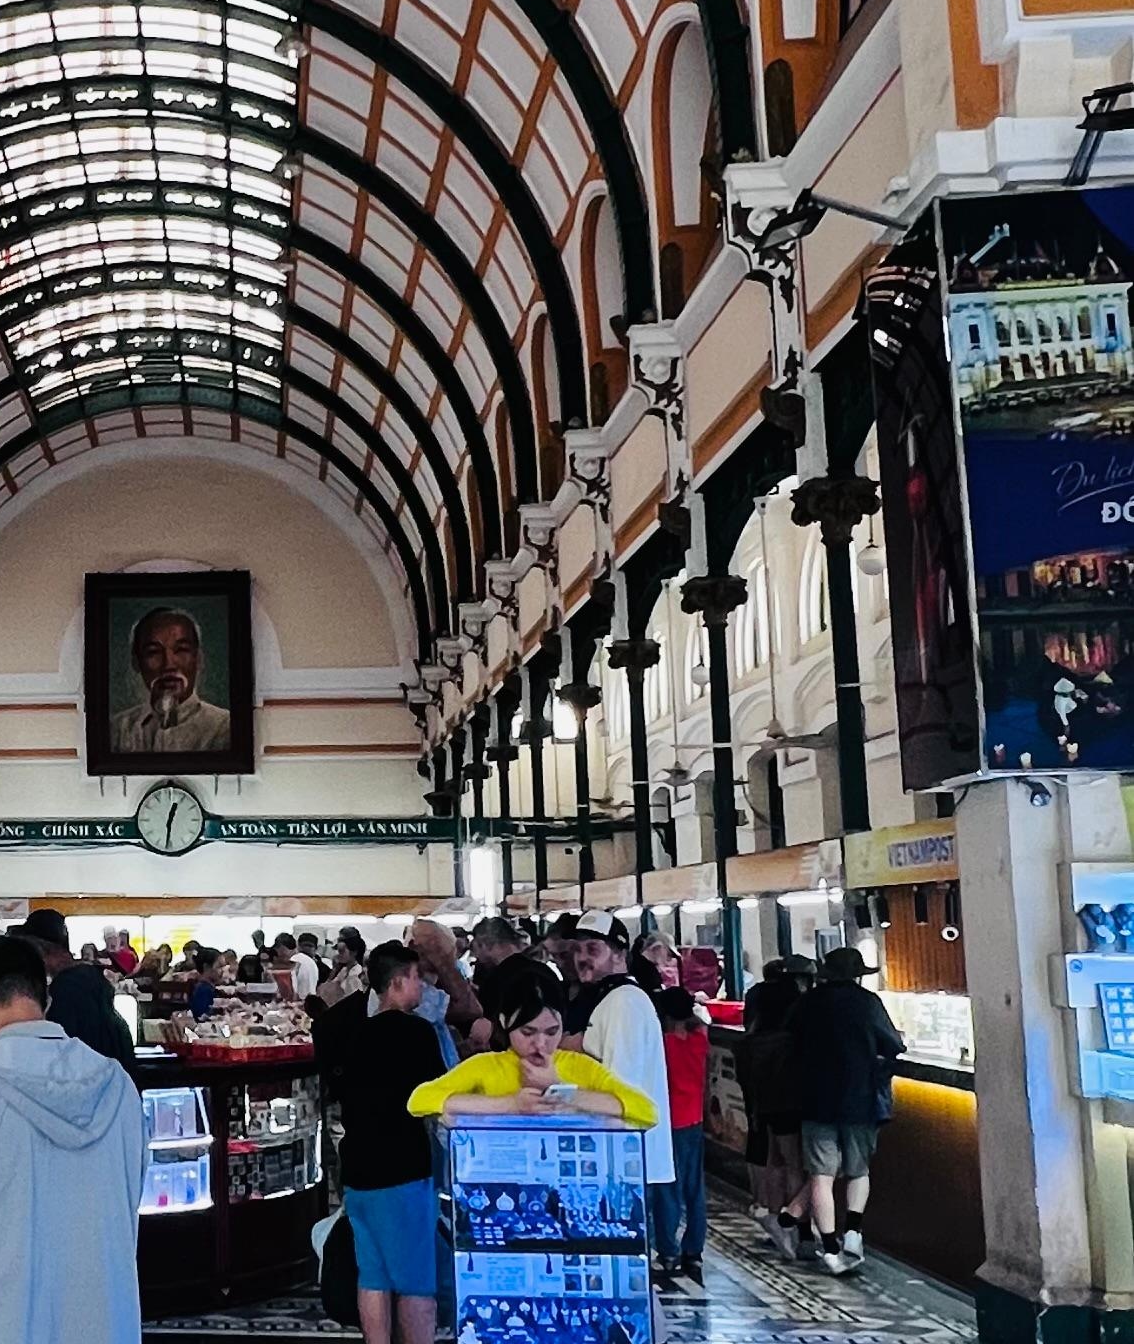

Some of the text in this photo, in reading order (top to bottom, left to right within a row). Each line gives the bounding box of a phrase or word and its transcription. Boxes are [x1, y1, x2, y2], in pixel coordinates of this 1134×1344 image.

[220, 823, 238, 836] AN
[239, 821, 278, 836] TOÀN
[390, 822, 428, 835] MINH
